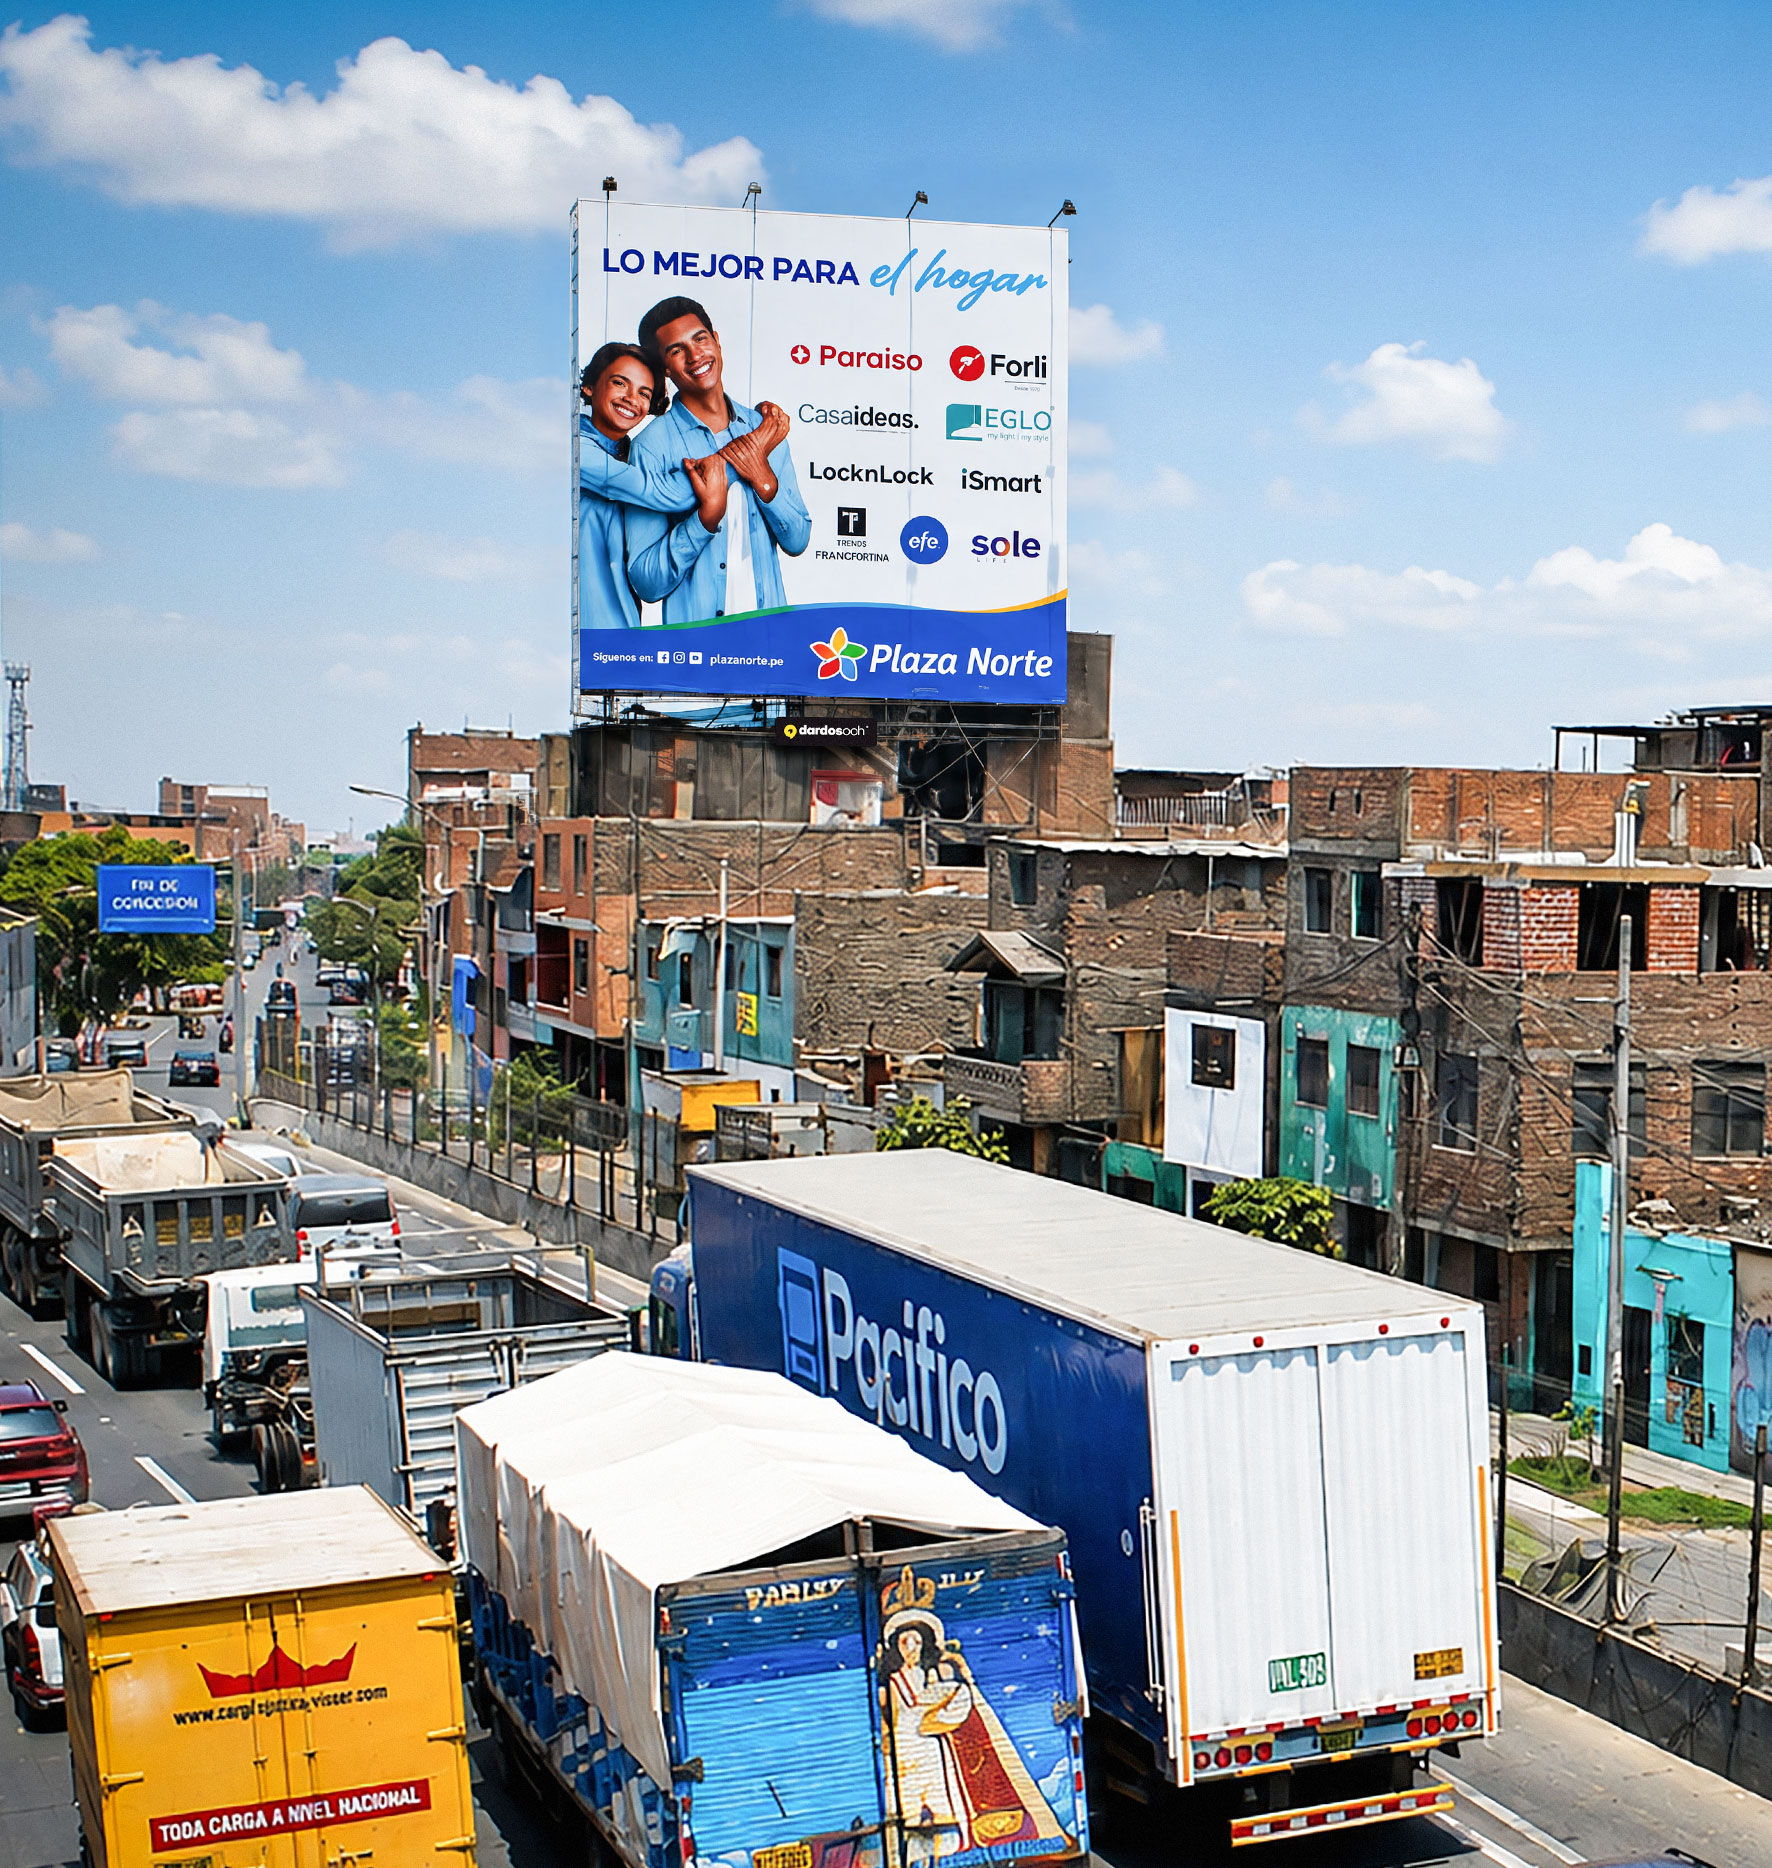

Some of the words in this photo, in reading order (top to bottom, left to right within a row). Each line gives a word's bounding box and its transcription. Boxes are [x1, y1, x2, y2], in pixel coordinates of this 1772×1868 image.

[603, 247, 645, 273] LO
[653, 250, 764, 280] MEJOR
[773, 258, 860, 286] PARA
[869, 247, 919, 296] el
[914, 248, 1049, 312] hogar
[819, 345, 923, 372] Paraiso
[990, 354, 1047, 379] Forli
[798, 403, 920, 429] Casaideas.
[809, 461, 935, 486] LocknLock
[961, 468, 1042, 494] iSmart
[836, 539, 868, 548] TRENDS
[908, 530, 939, 553] efe
[970, 530, 1041, 559] sole
[815, 550, 890, 562] FRANCFORTINA
[592, 651, 637, 664] Síguenos
[638, 653, 654, 664] en:
[709, 654, 785, 668] plazanorte.pe
[869, 643, 958, 676] Plaza
[966, 647, 1053, 678] Norte
[158, 1818, 206, 1843] TODA
[208, 1809, 269, 1836] CARGA
[272, 1807, 285, 1826] A
